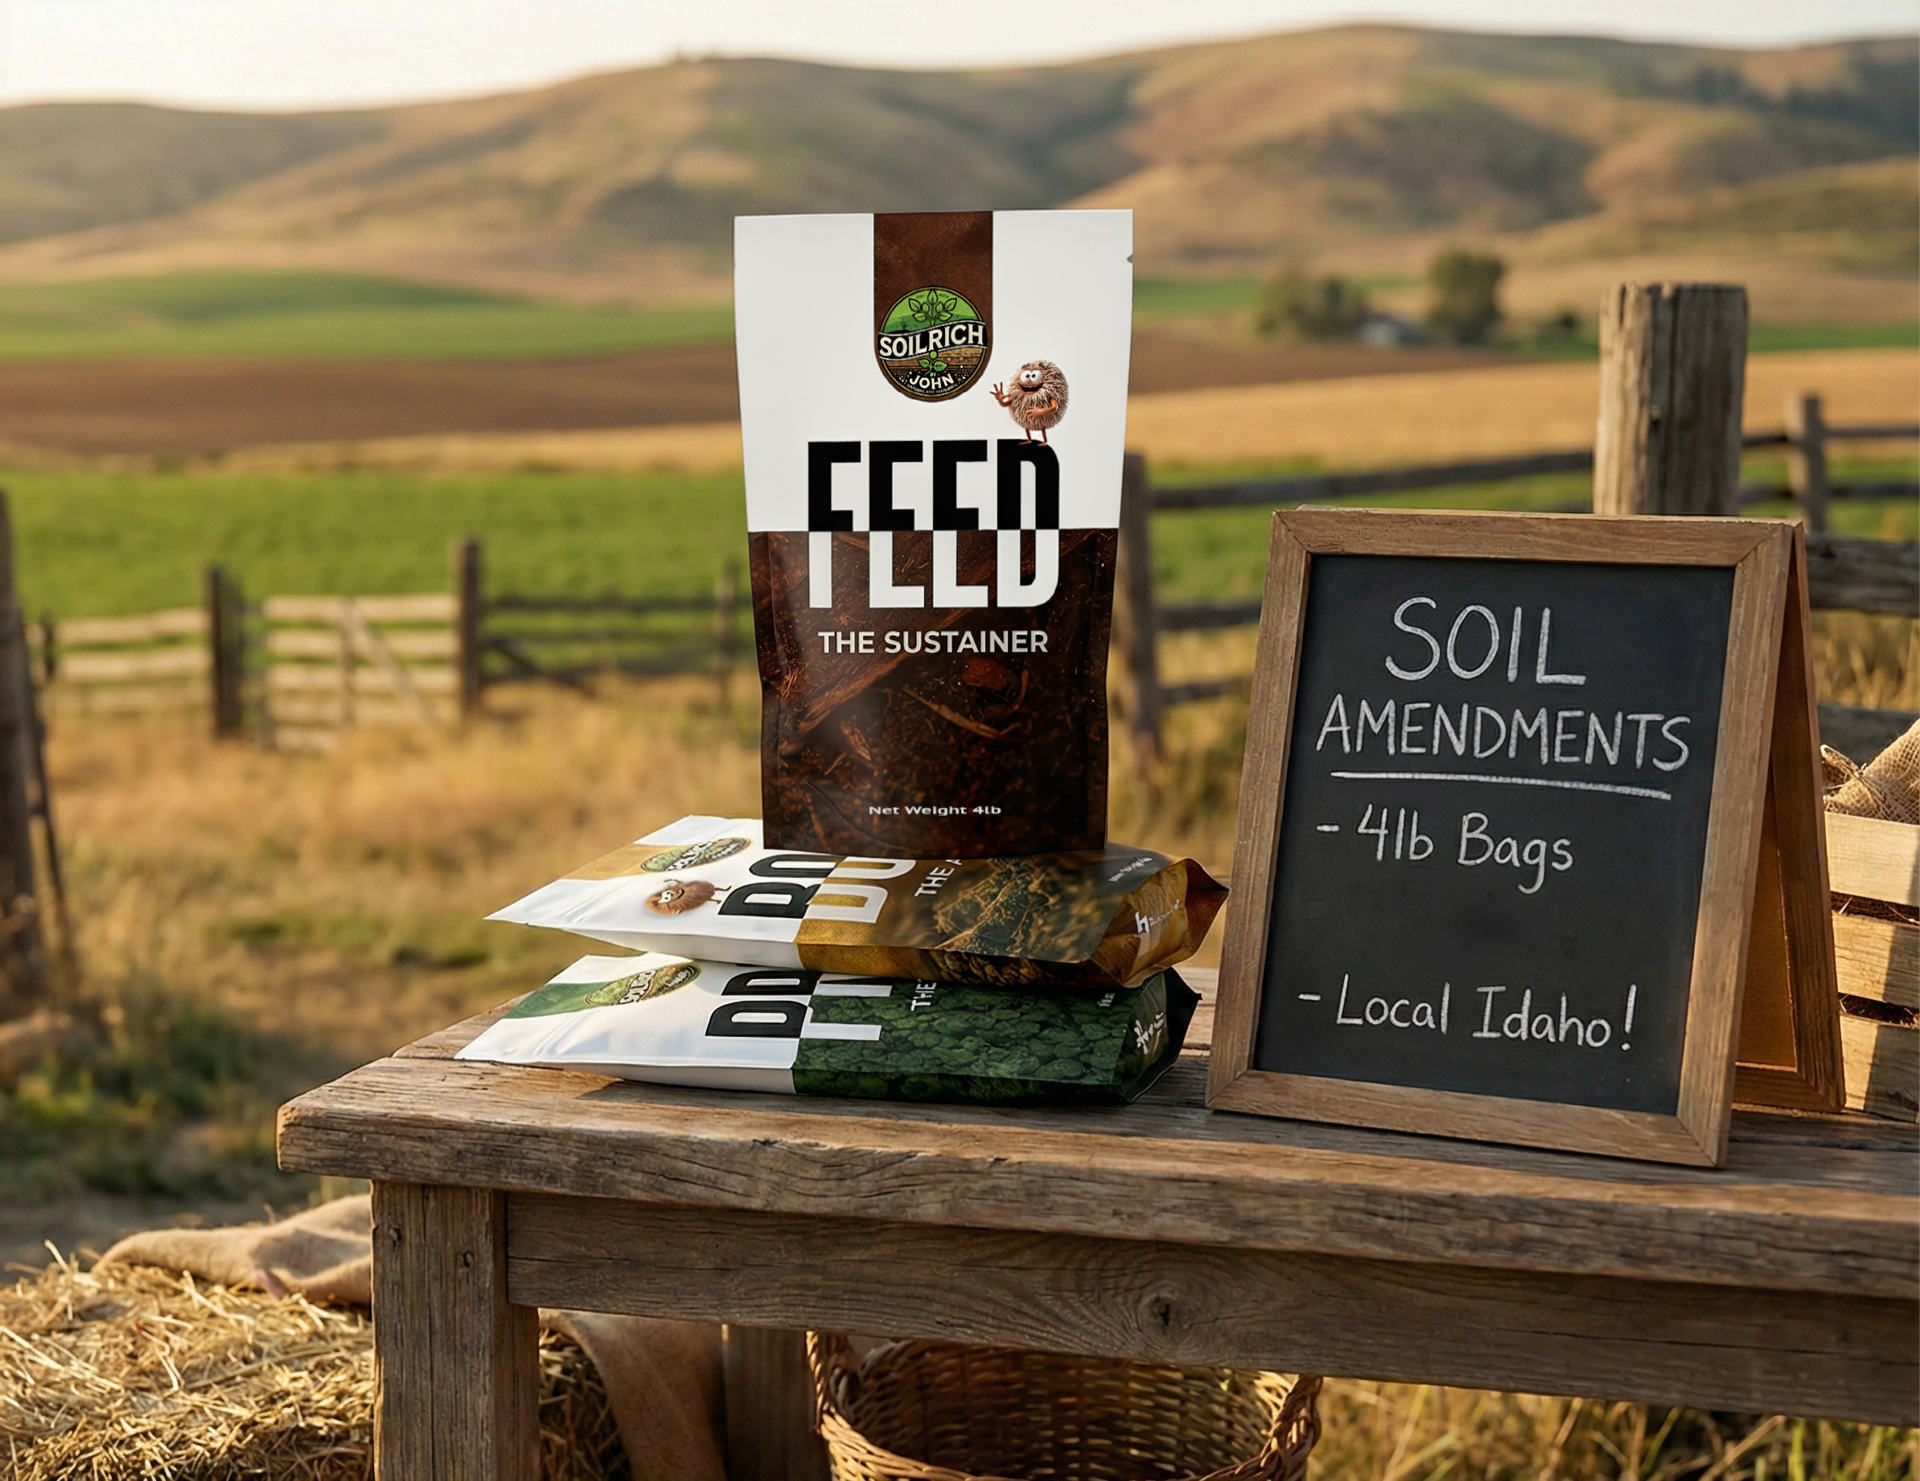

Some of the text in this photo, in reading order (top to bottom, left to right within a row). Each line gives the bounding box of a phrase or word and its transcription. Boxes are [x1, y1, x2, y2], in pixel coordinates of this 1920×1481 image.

[879, 323, 984, 357] SOILRICH
[909, 373, 955, 390] JOHN
[809, 439, 1060, 608] FEED
[817, 630, 1048, 654] THE SUSTAINER
[1385, 596, 1586, 685] SOIL
[1316, 694, 1691, 771] AMENDMENTS
[868, 805, 1002, 817] Net Weight 4lb
[1357, 803, 1434, 861] 4lb
[1457, 812, 1573, 894] Bags
[914, 867, 945, 897] THE
[910, 983, 937, 1012] THE
[1336, 973, 1450, 1034] Local
[1472, 984, 1637, 1051] Idaho!
